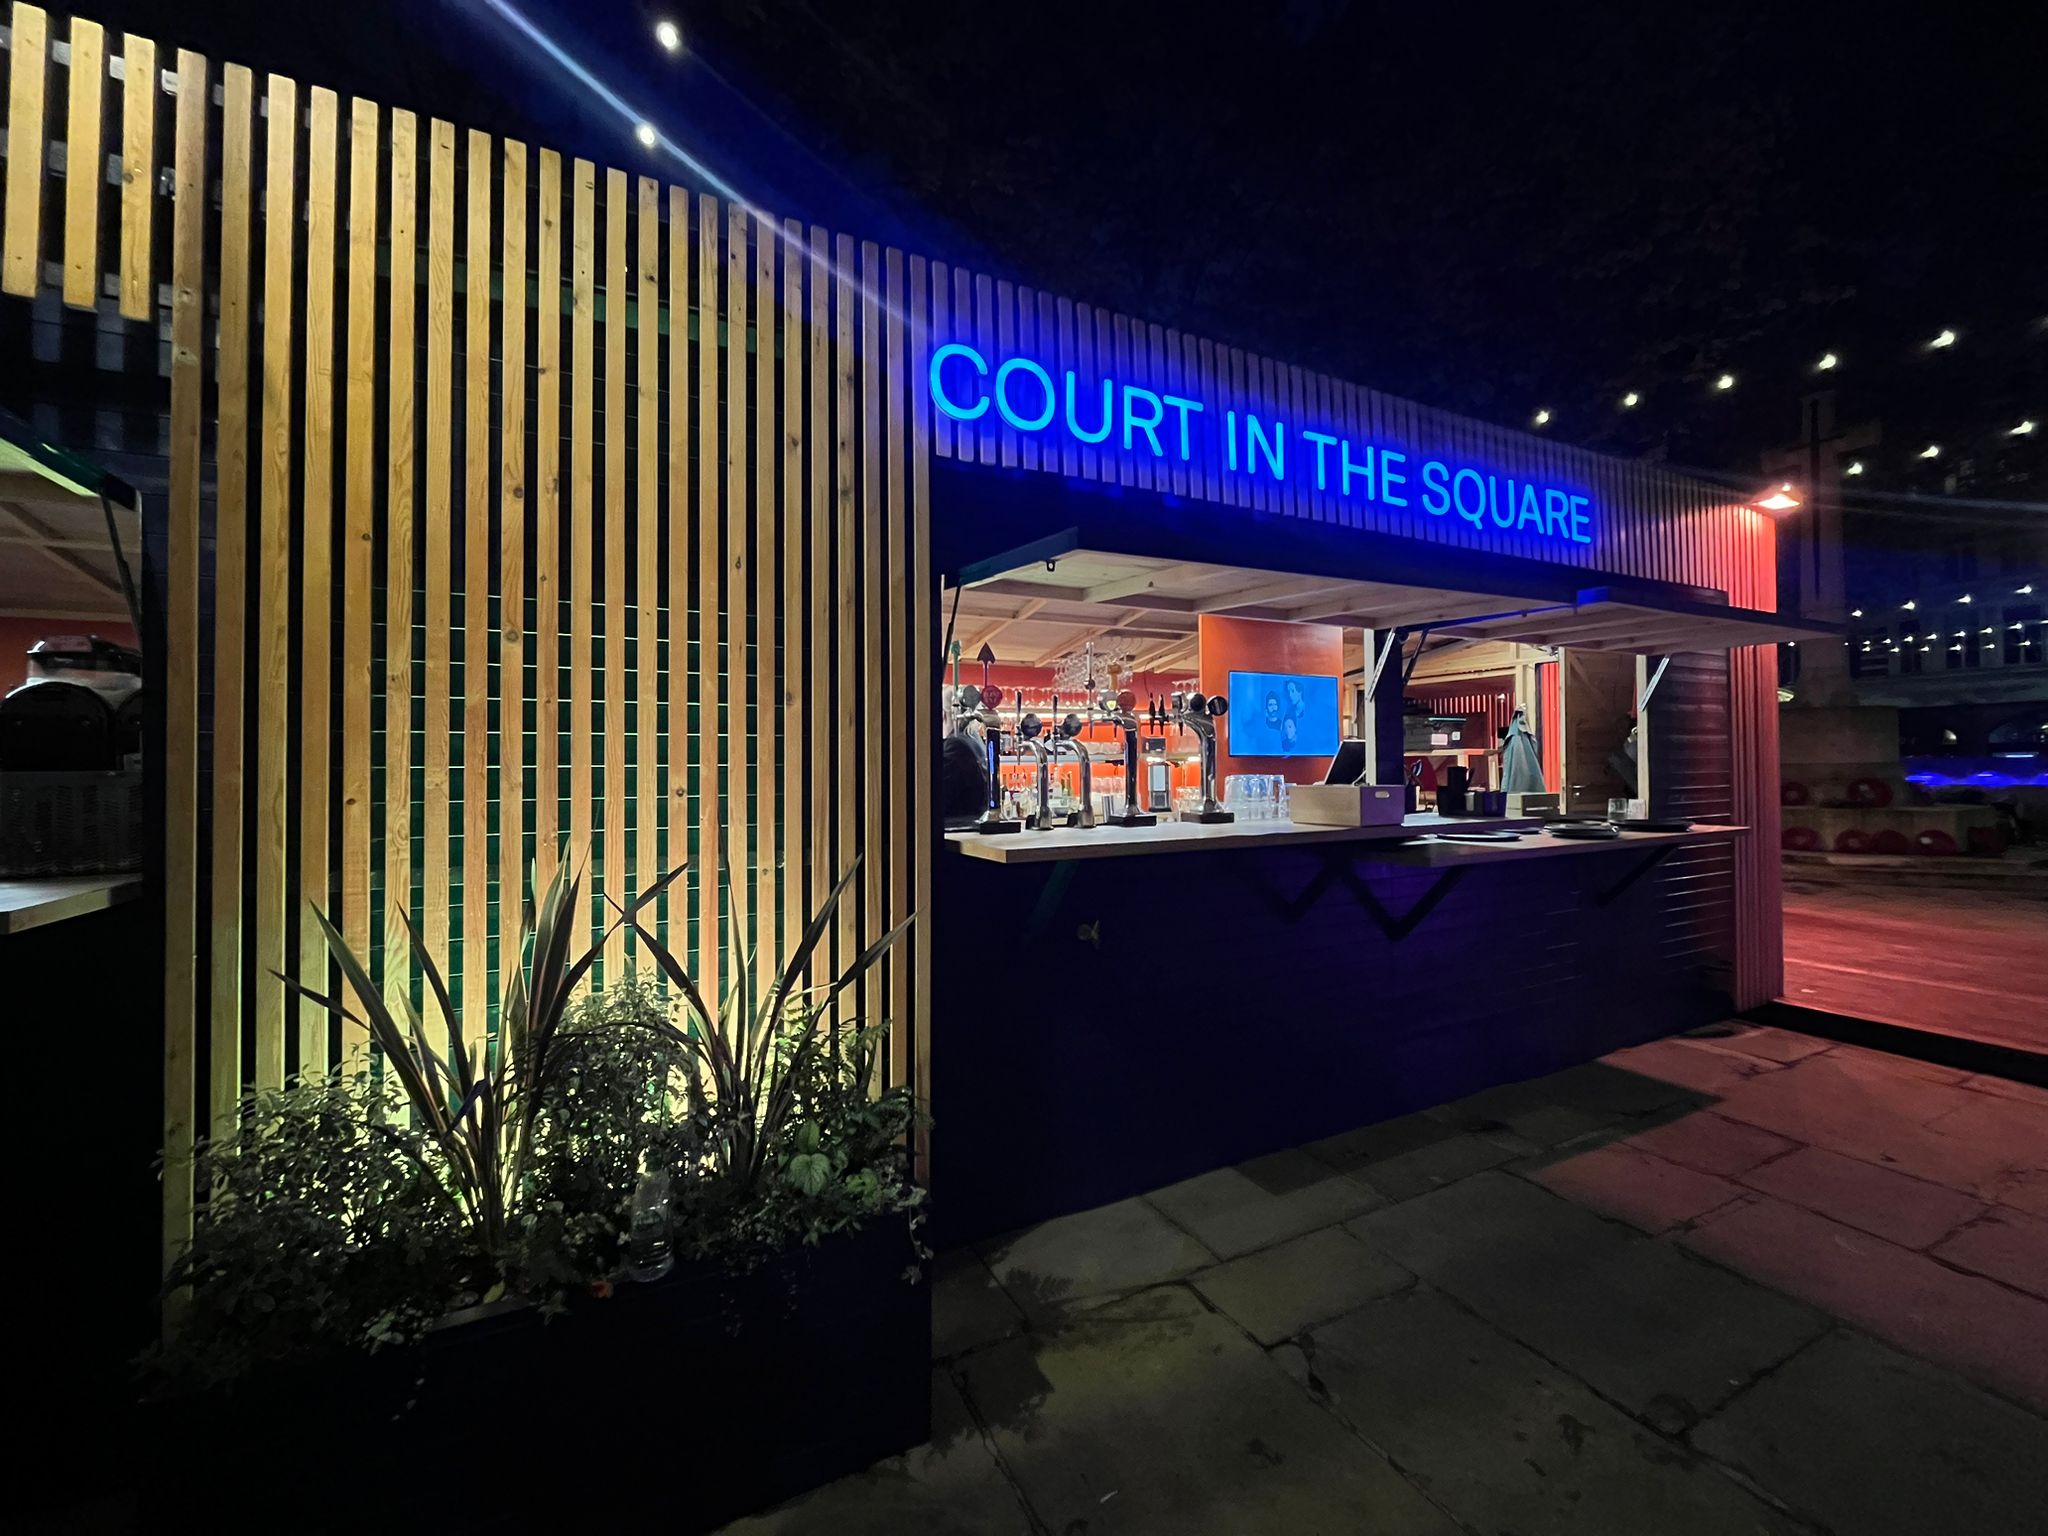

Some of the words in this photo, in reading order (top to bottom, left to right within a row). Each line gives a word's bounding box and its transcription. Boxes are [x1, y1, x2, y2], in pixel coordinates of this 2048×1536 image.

[929, 343, 1204, 461] COURT
[1226, 410, 1285, 481] IN
[1302, 430, 1408, 508] THE
[1421, 460, 1593, 545] SQUARE
